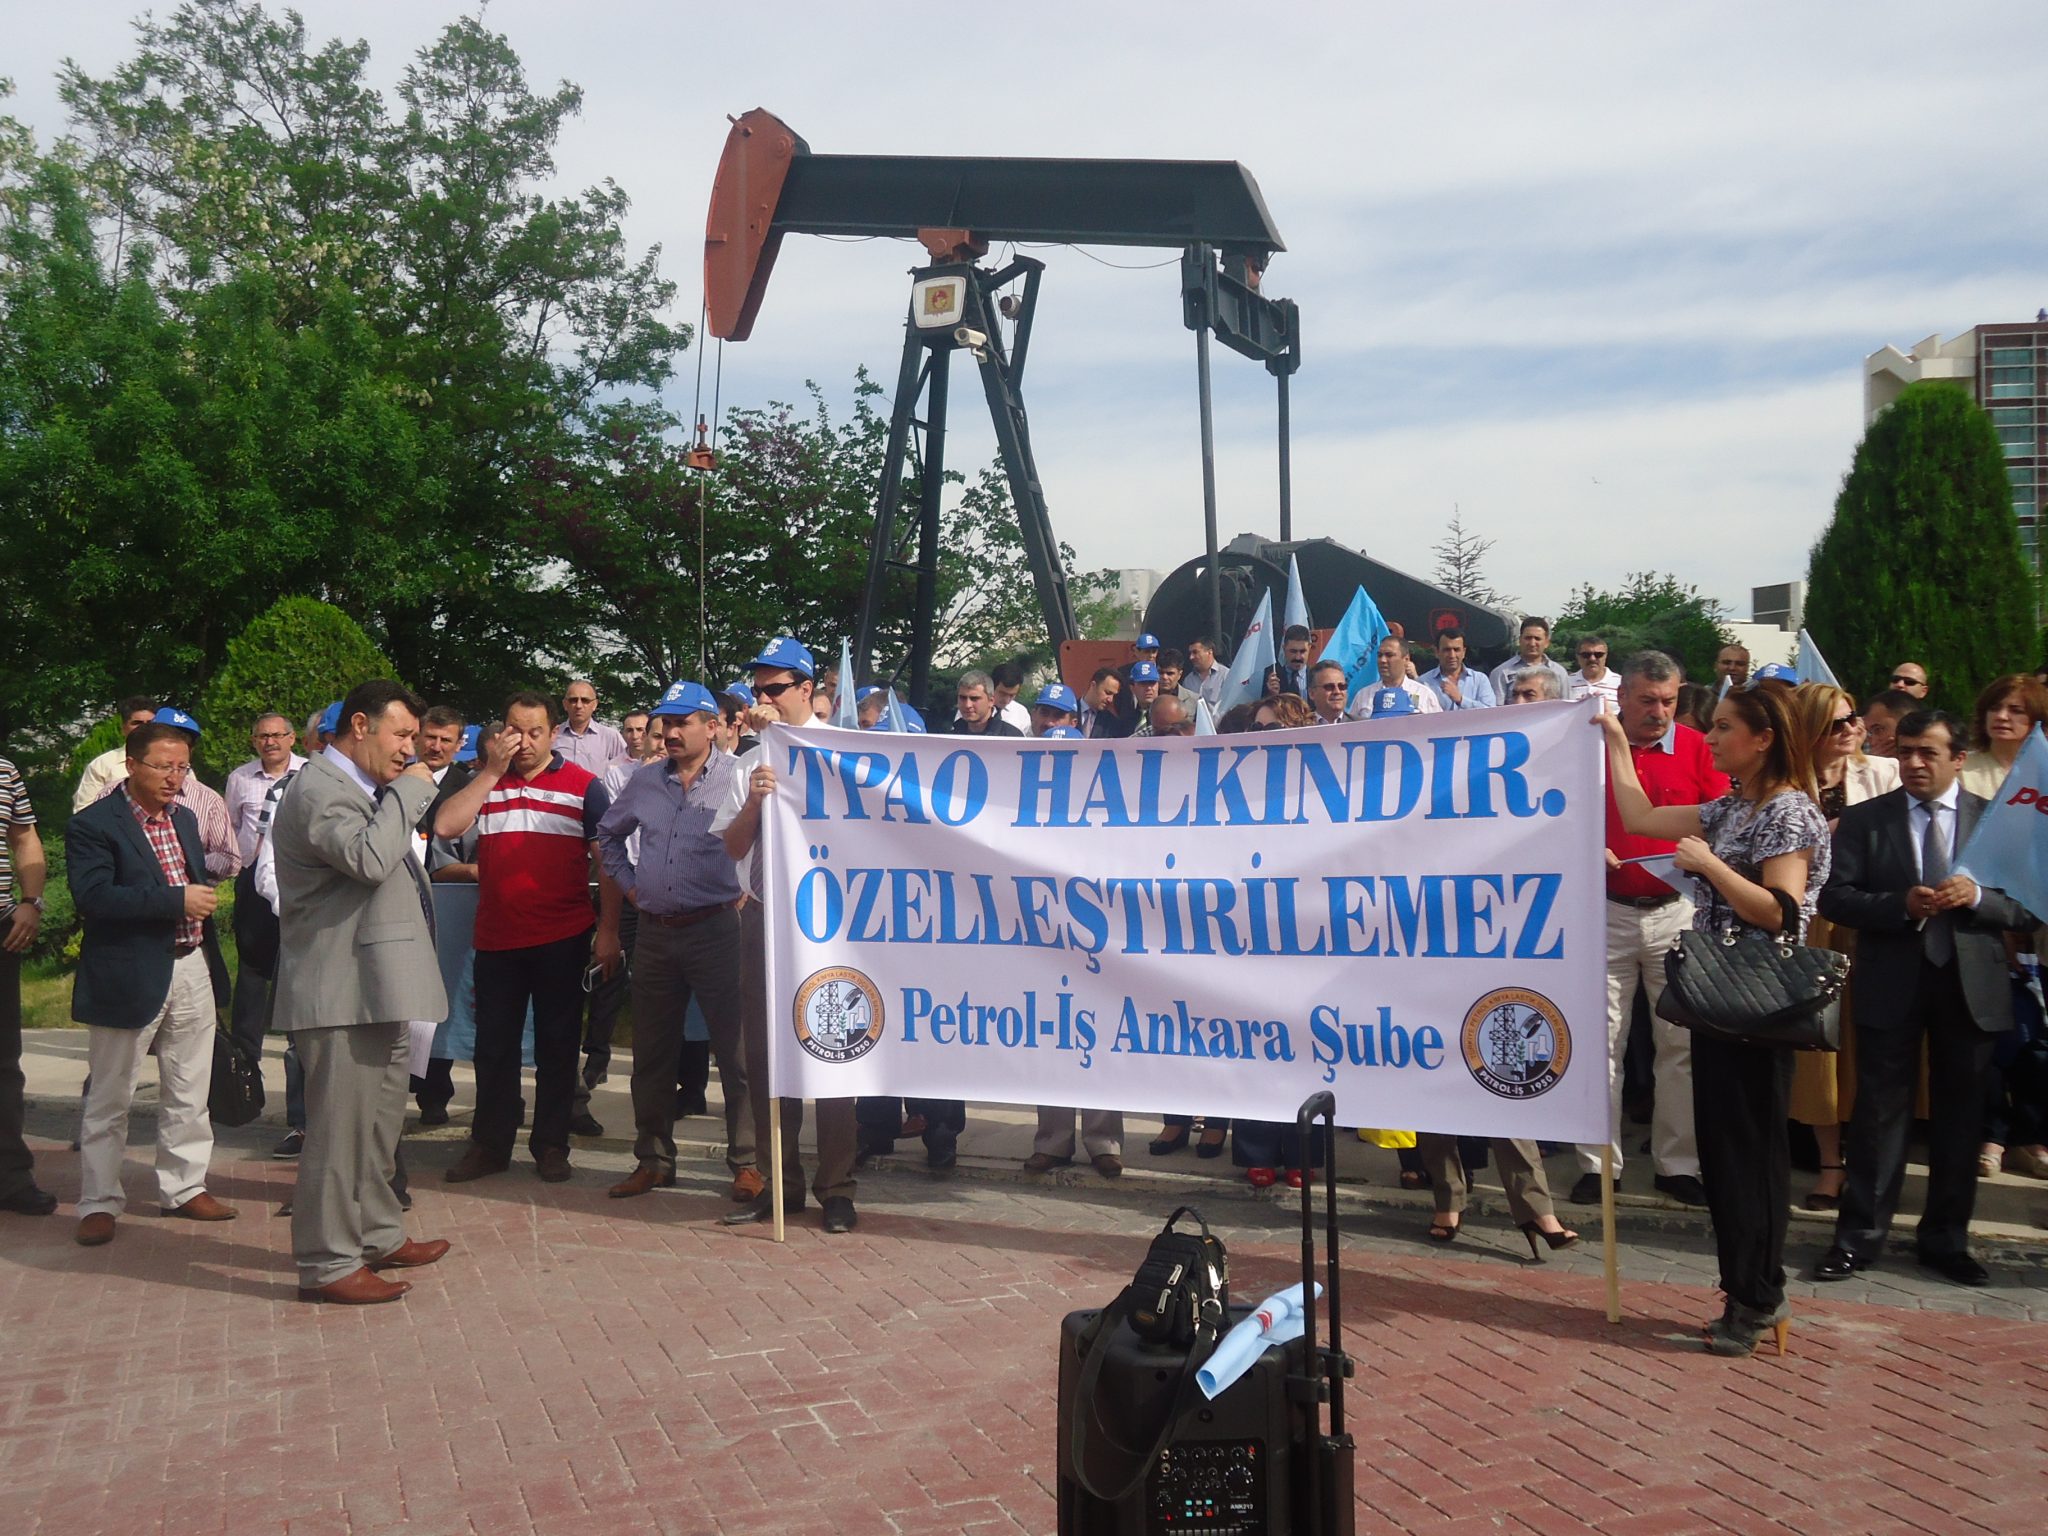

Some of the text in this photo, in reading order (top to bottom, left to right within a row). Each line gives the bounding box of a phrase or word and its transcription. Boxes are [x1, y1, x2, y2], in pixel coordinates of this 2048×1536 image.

[789, 731, 1566, 827] TPAO HALKINDIR.
[795, 845, 1565, 973] ÖZELLEŞTİRİLEMEZ
[850, 1040, 870, 1056] 1950
[900, 975, 1445, 1083] Petrol-İş Ankara Şube
[1530, 1074, 1553, 1092] 1950
